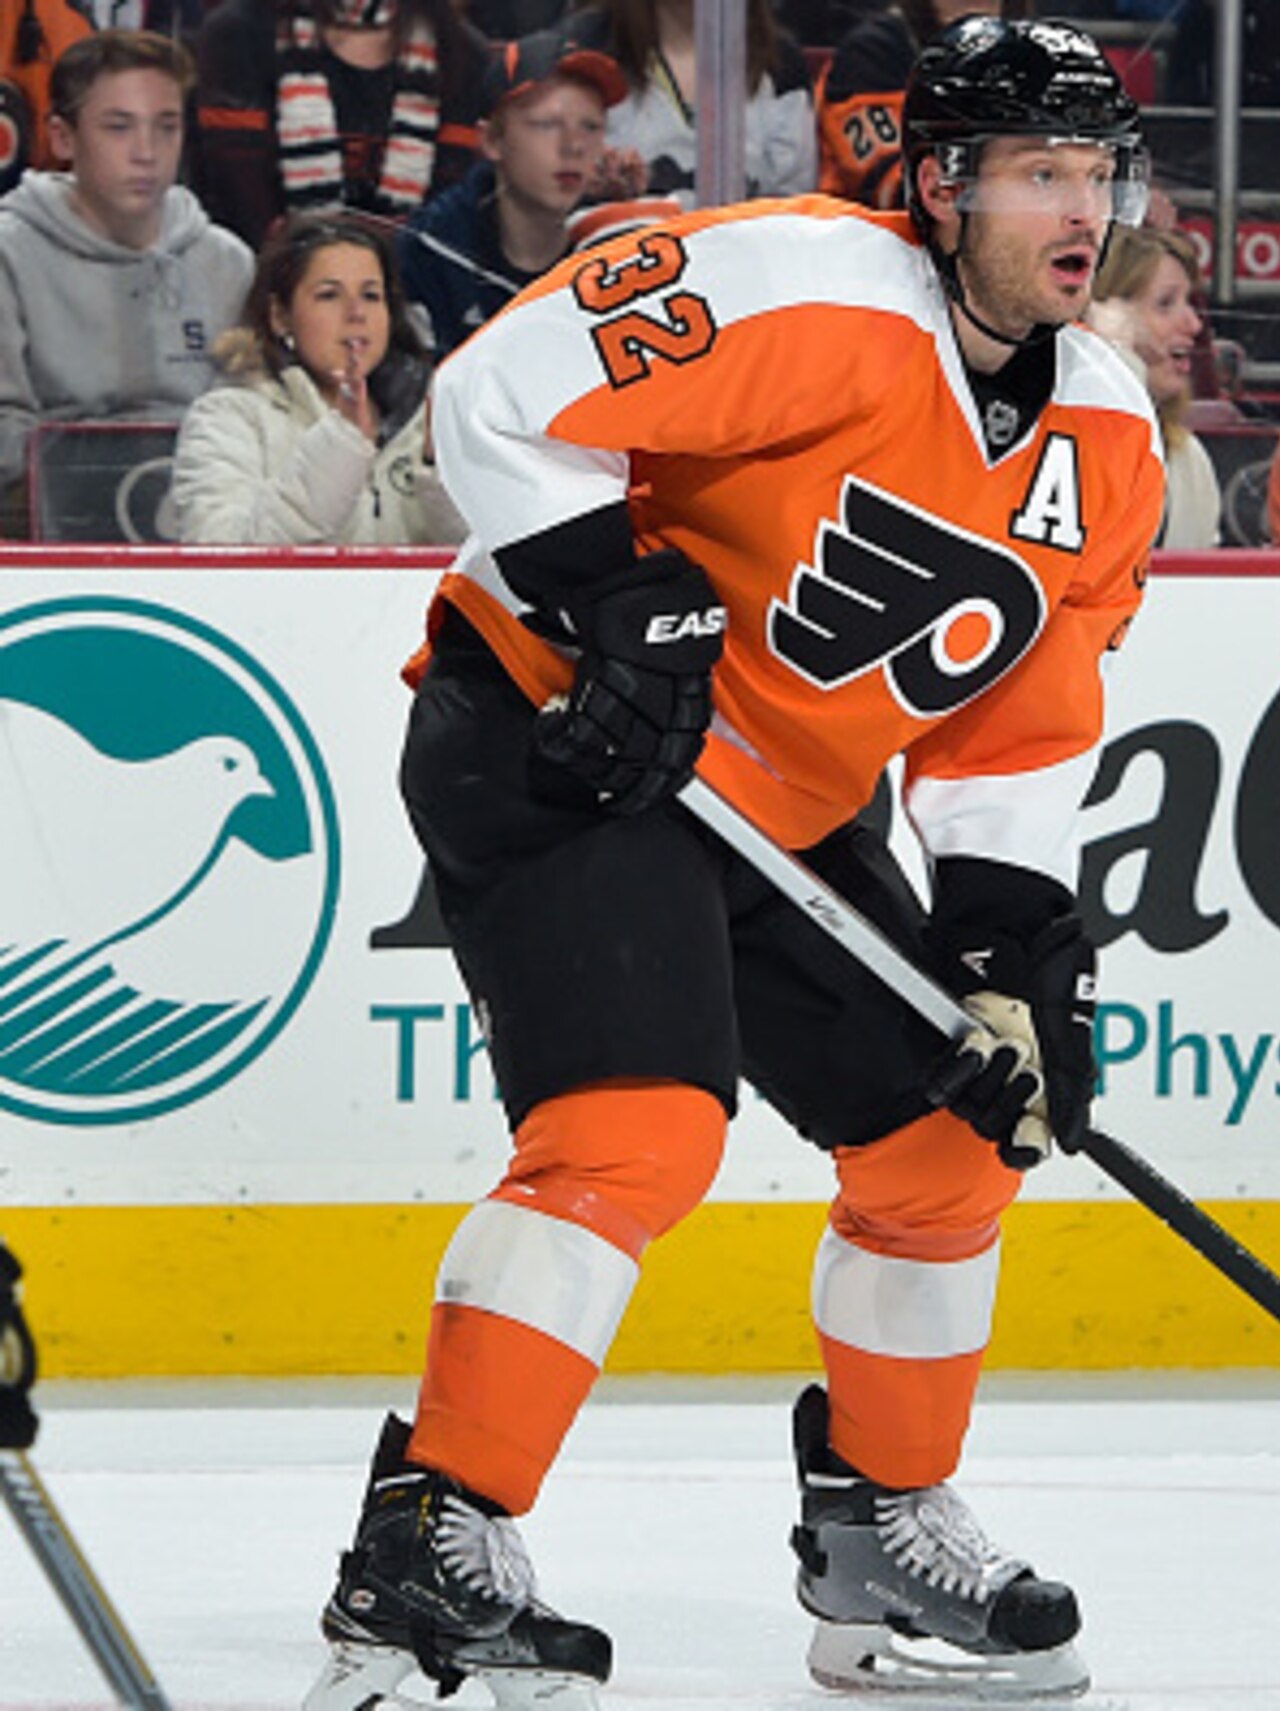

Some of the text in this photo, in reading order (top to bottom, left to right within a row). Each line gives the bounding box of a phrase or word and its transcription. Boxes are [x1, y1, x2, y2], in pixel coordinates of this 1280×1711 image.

[842, 105, 898, 161] 28
[573, 232, 717, 391] 32
[1009, 431, 1087, 556] A
